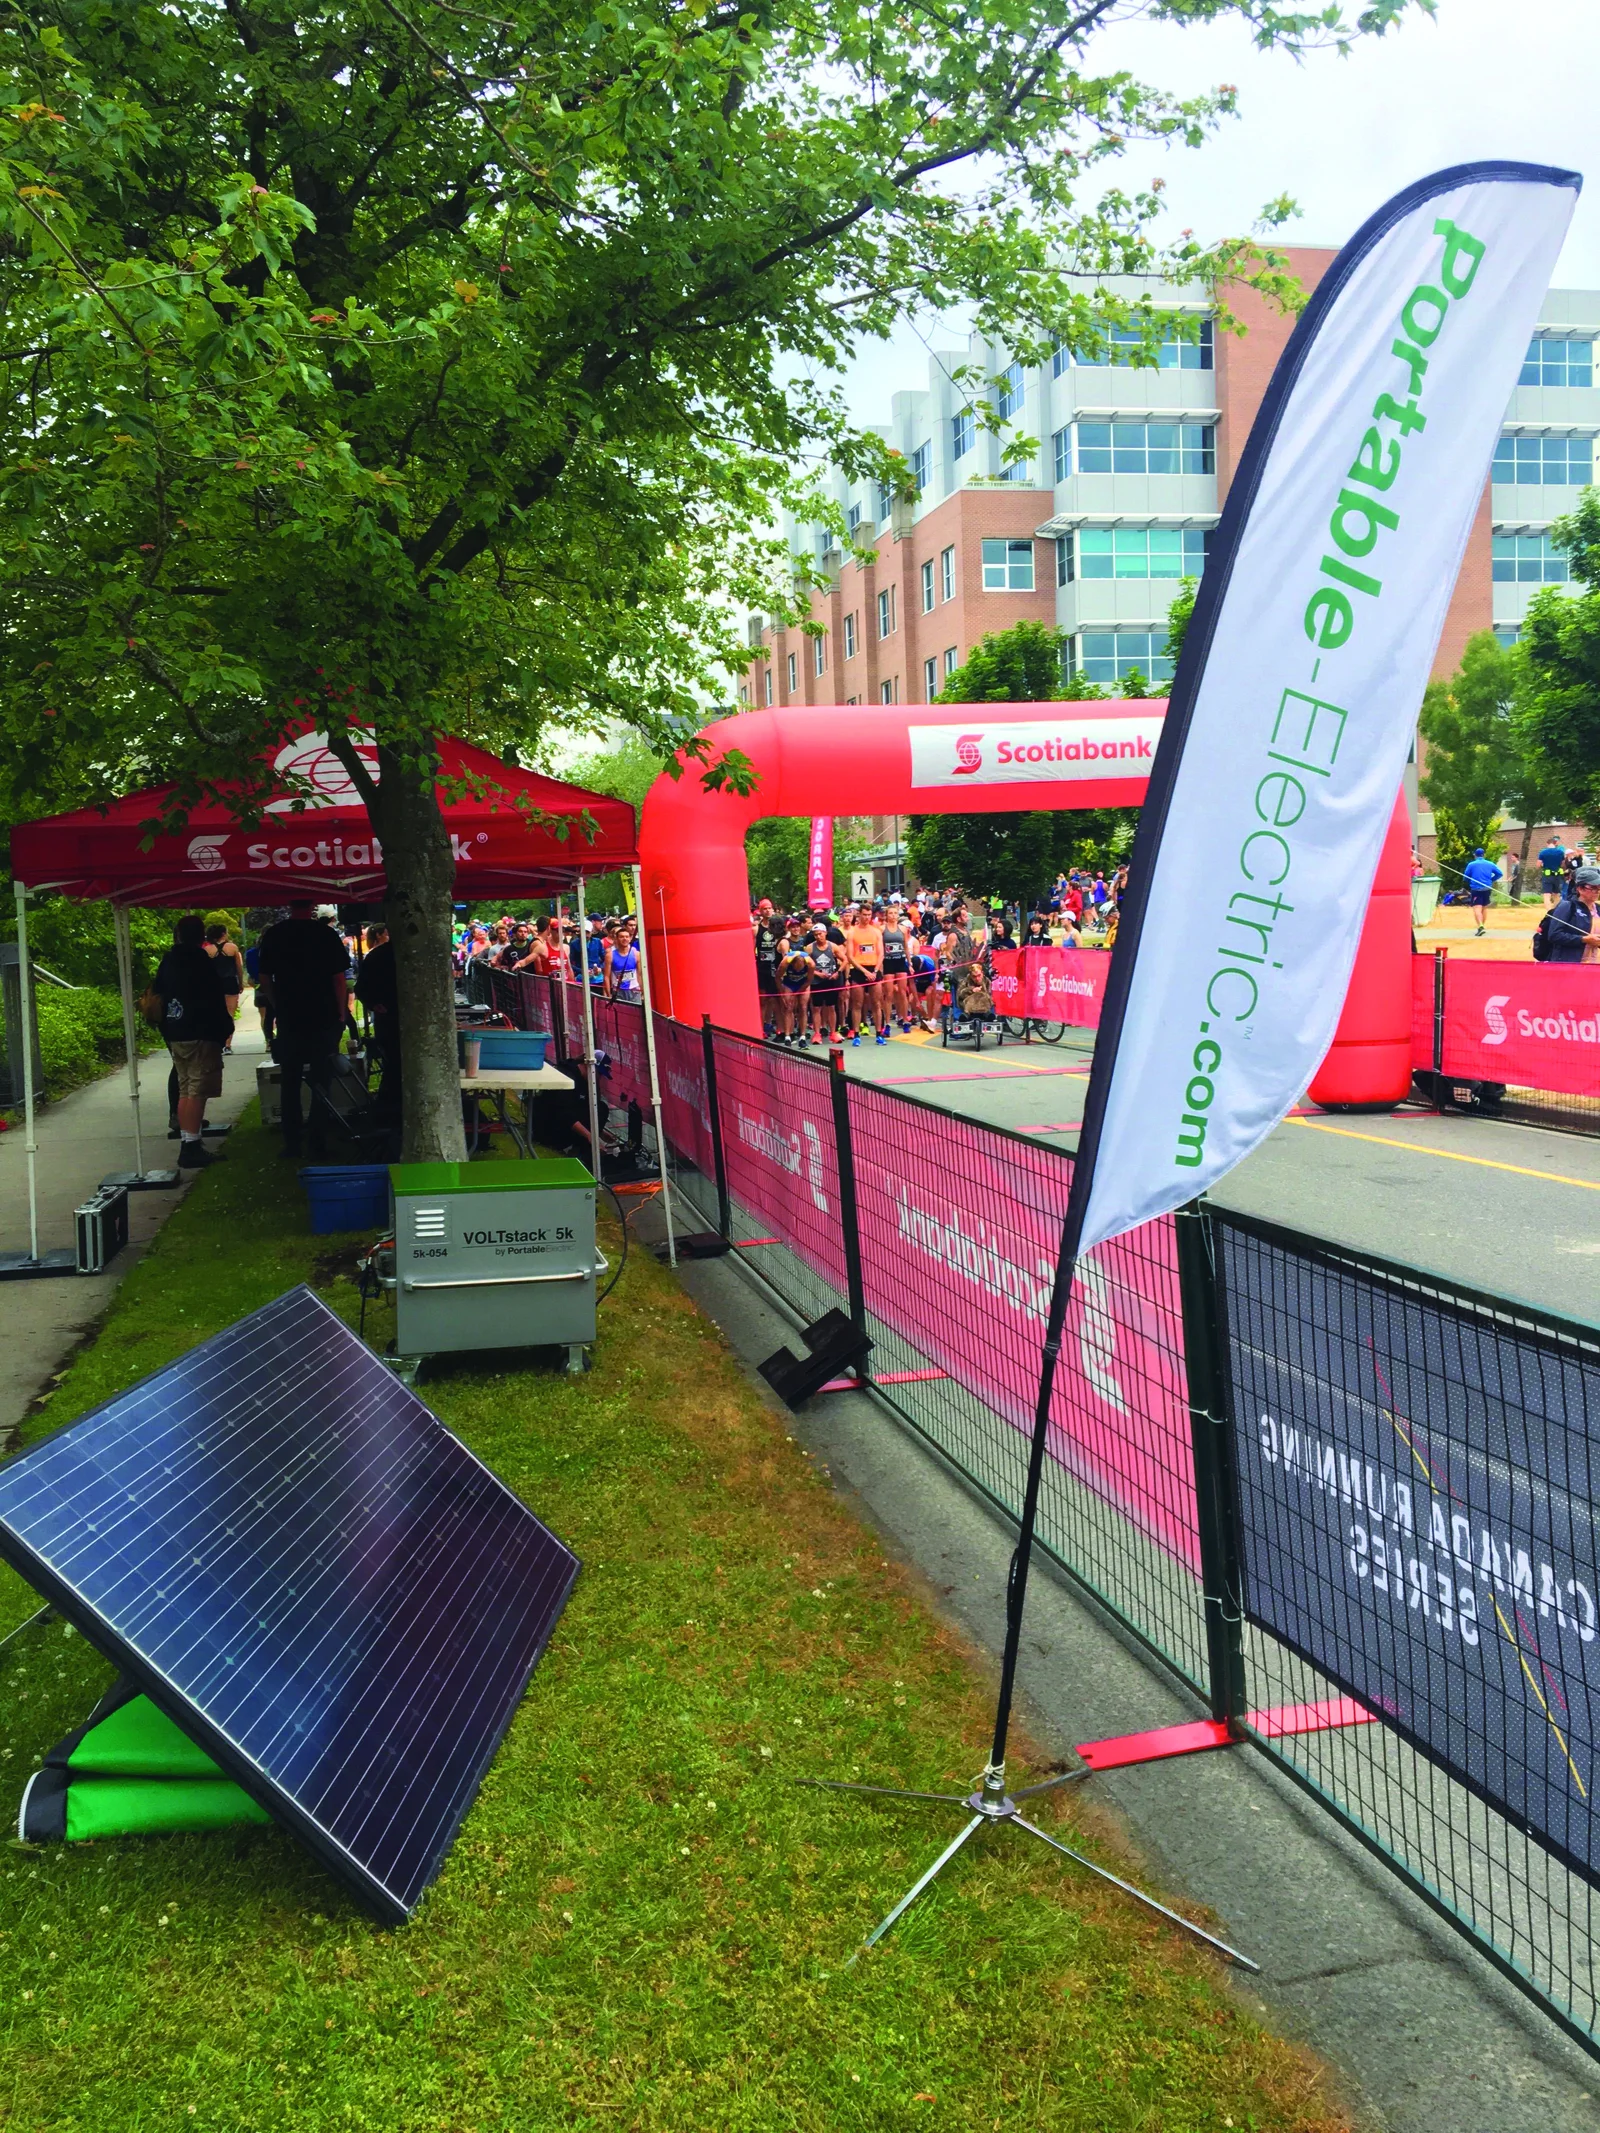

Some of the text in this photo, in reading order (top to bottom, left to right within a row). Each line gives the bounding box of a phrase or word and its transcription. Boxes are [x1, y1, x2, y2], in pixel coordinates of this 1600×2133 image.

[996, 735, 1152, 764] Scotiabank
[1049, 974, 1093, 998] Scotiabank
[1516, 1009, 1600, 1043] Scotia
[555, 1227, 574, 1240] 5k
[413, 1248, 448, 1259] 5k-054
[495, 1247, 505, 1257] by
